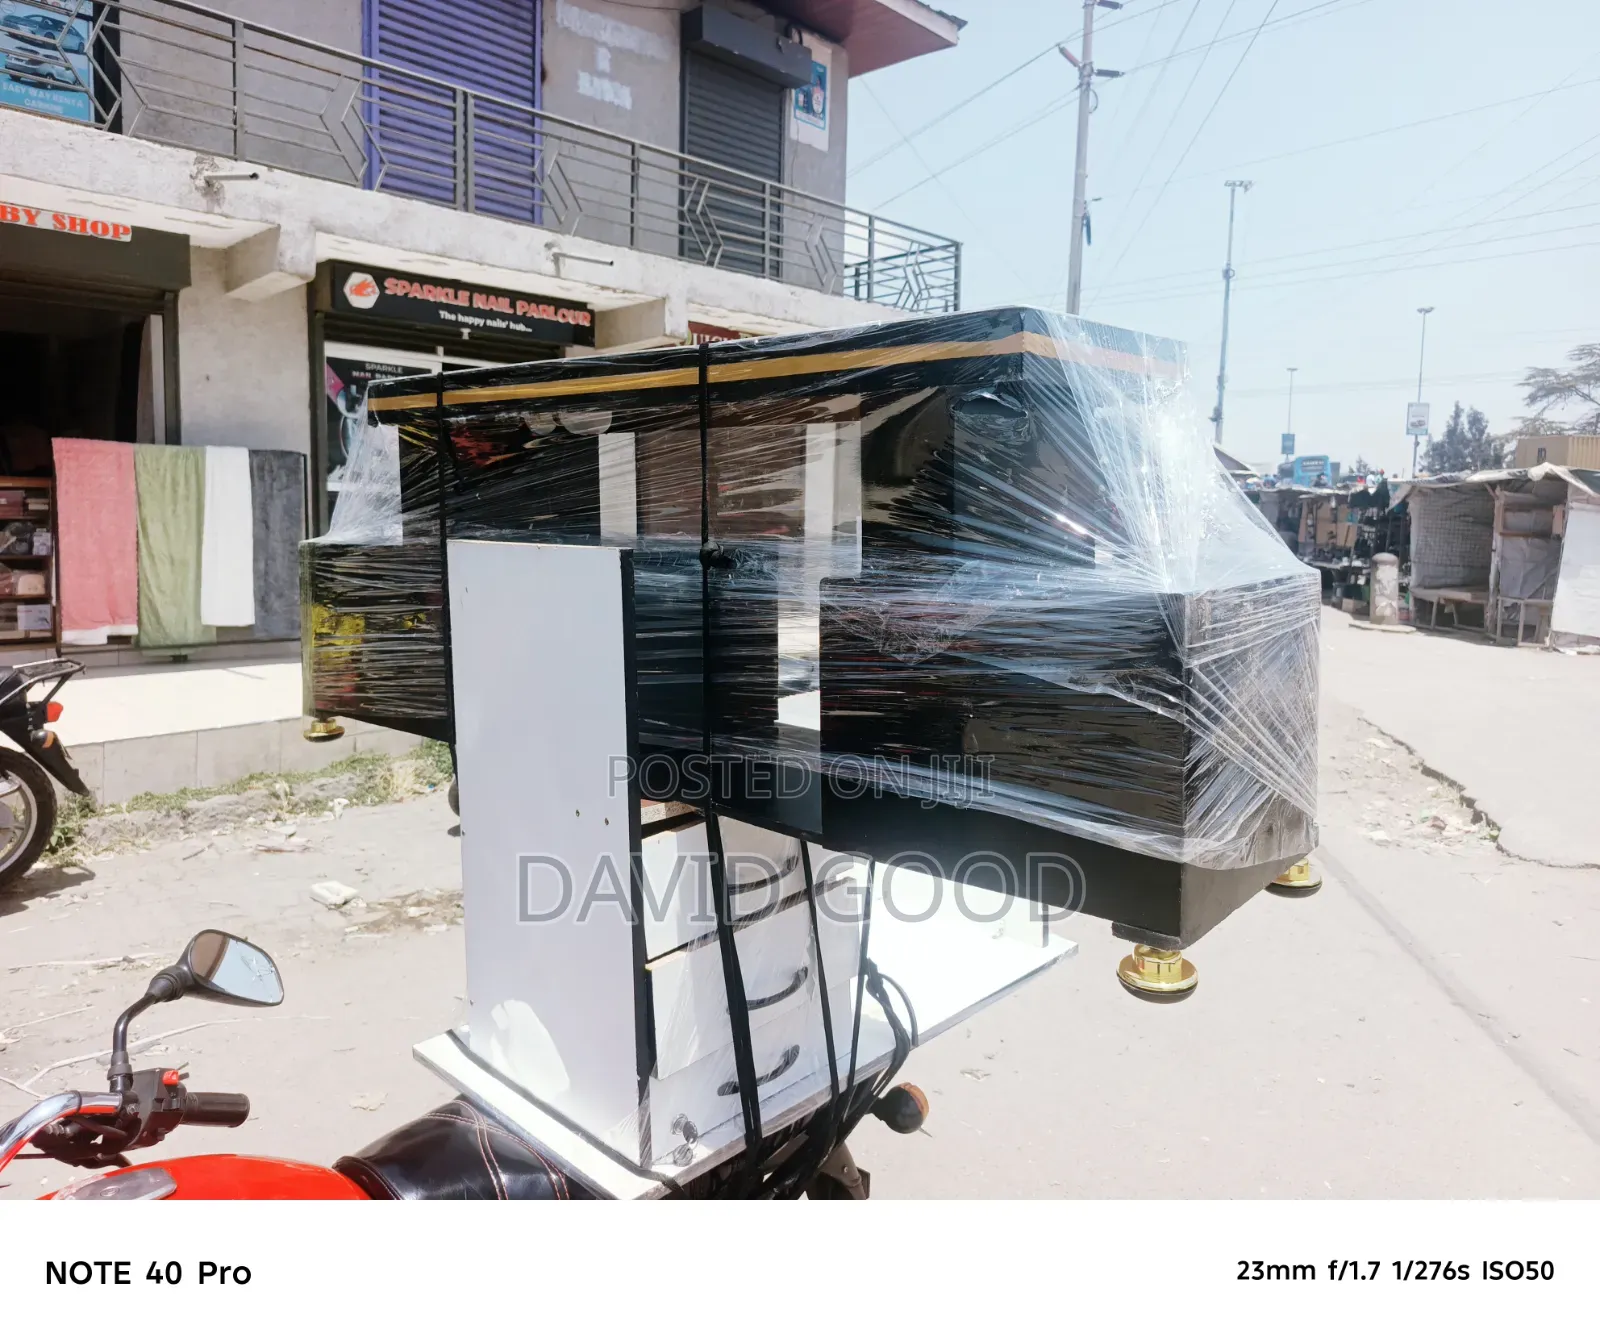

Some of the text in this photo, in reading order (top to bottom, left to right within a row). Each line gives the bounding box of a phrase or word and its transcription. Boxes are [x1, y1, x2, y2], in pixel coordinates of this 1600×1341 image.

[52, 212, 131, 238] SHOP
[384, 277, 591, 327] SPARKLE NAIL PARLOUR
[439, 310, 457, 321] The
[457, 313, 485, 327] happy
[365, 363, 403, 374] SPARKLE
